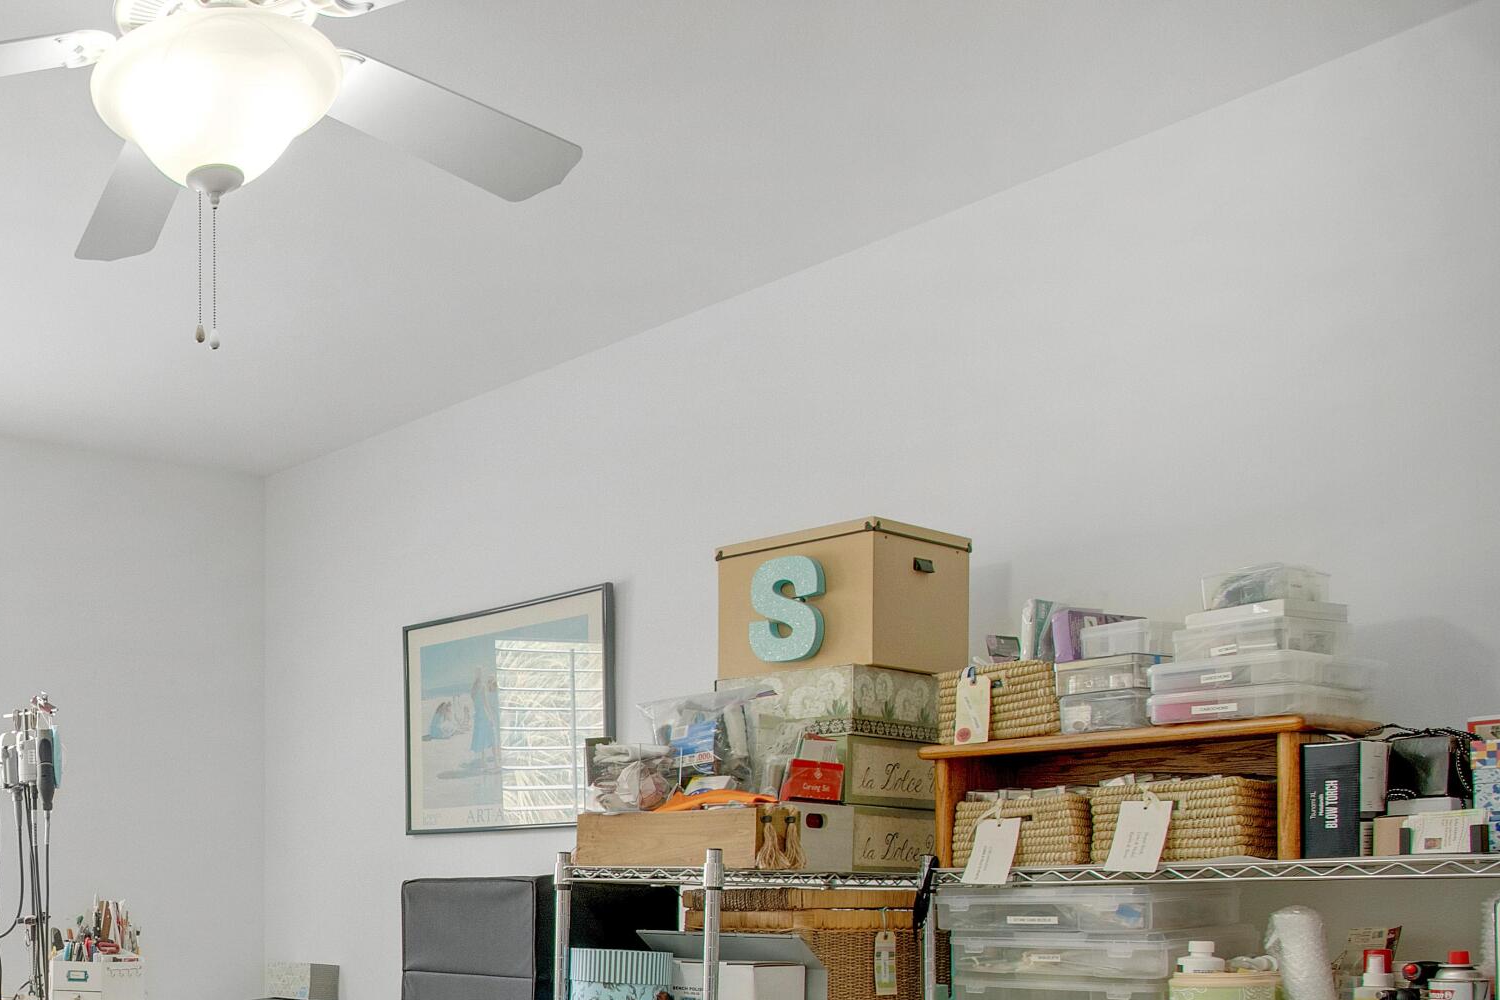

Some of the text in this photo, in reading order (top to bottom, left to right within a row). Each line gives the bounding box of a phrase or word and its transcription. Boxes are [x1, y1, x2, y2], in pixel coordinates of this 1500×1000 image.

[748, 555, 826, 663] S
[881, 762, 922, 793] Dolce
[1325, 780, 1338, 829] BLOW TORCH
[881, 832, 920, 862] Dolce
